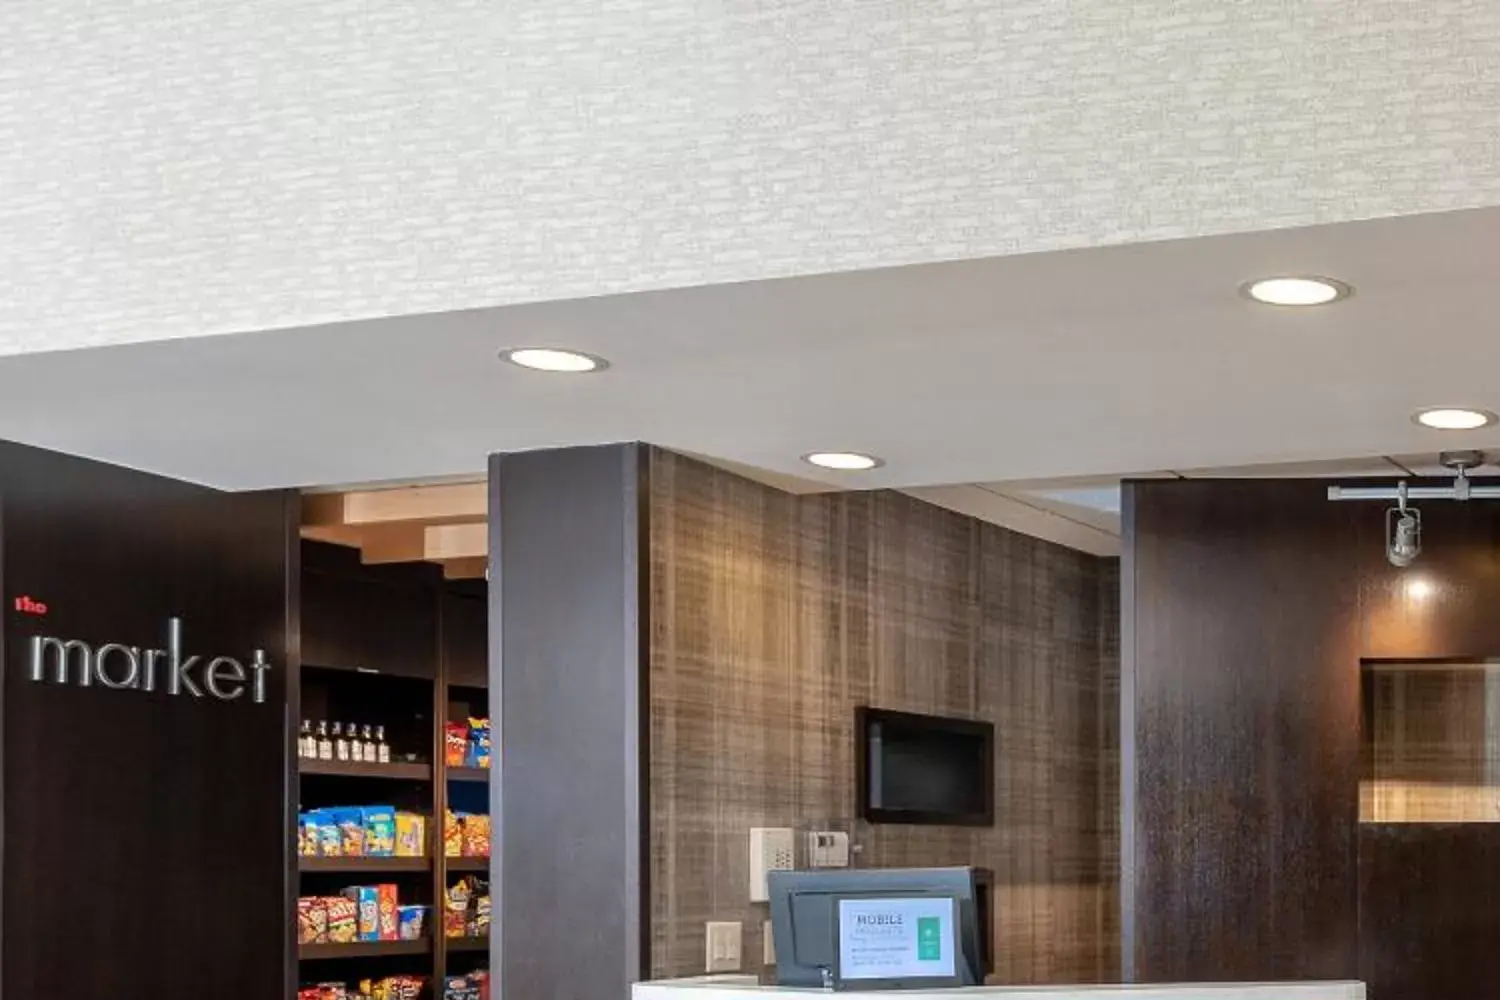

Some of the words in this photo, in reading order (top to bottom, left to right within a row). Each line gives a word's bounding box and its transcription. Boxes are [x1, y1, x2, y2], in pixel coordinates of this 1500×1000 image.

[14, 595, 48, 615] the
[30, 616, 272, 703] market
[856, 914, 903, 925] MOBILE
